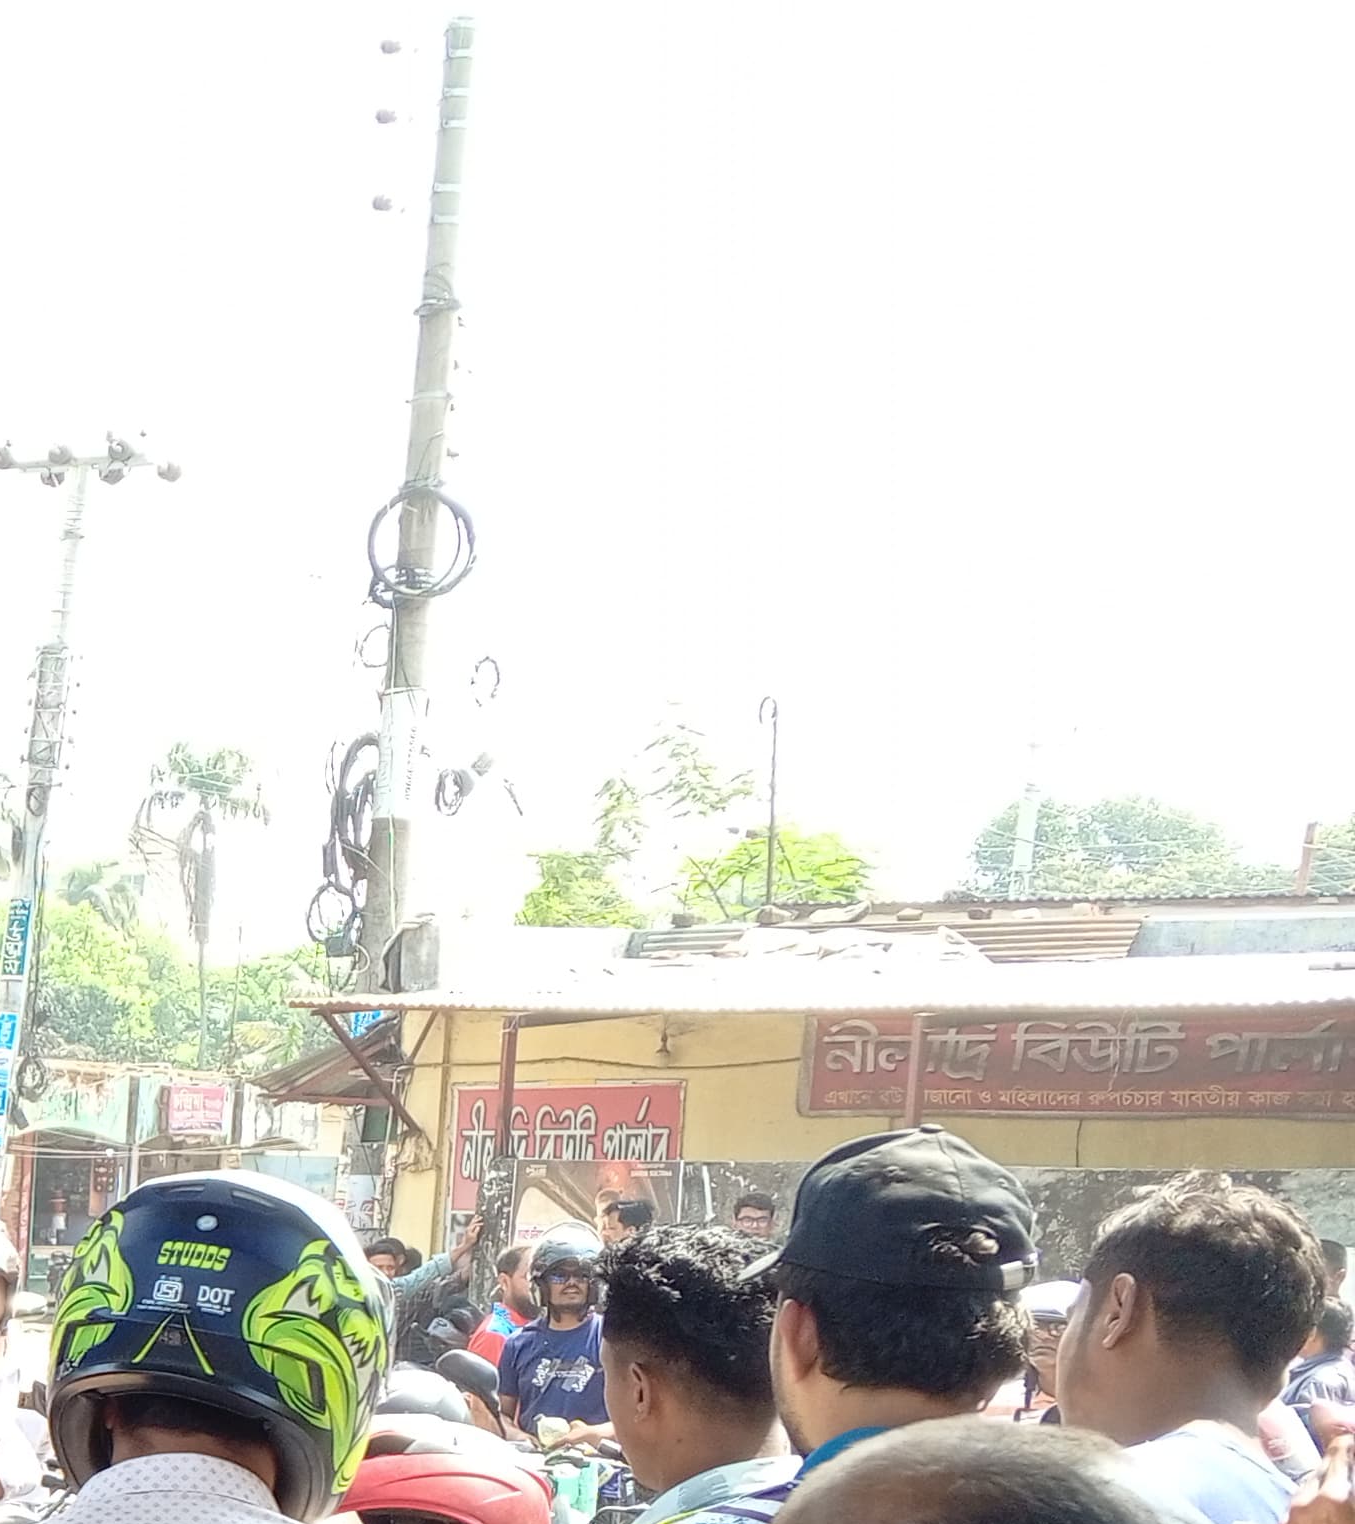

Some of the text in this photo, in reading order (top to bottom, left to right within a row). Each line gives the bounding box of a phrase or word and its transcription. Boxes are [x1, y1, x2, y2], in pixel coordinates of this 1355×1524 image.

[1011, 1021, 1187, 1074] বিউটি
[1206, 1019, 1355, 1073] পার্লা
[923, 1088, 972, 1106] াজানো
[978, 1091, 992, 1104] ও
[157, 1241, 232, 1272] STUDDS
[197, 1285, 236, 1306] DOT
